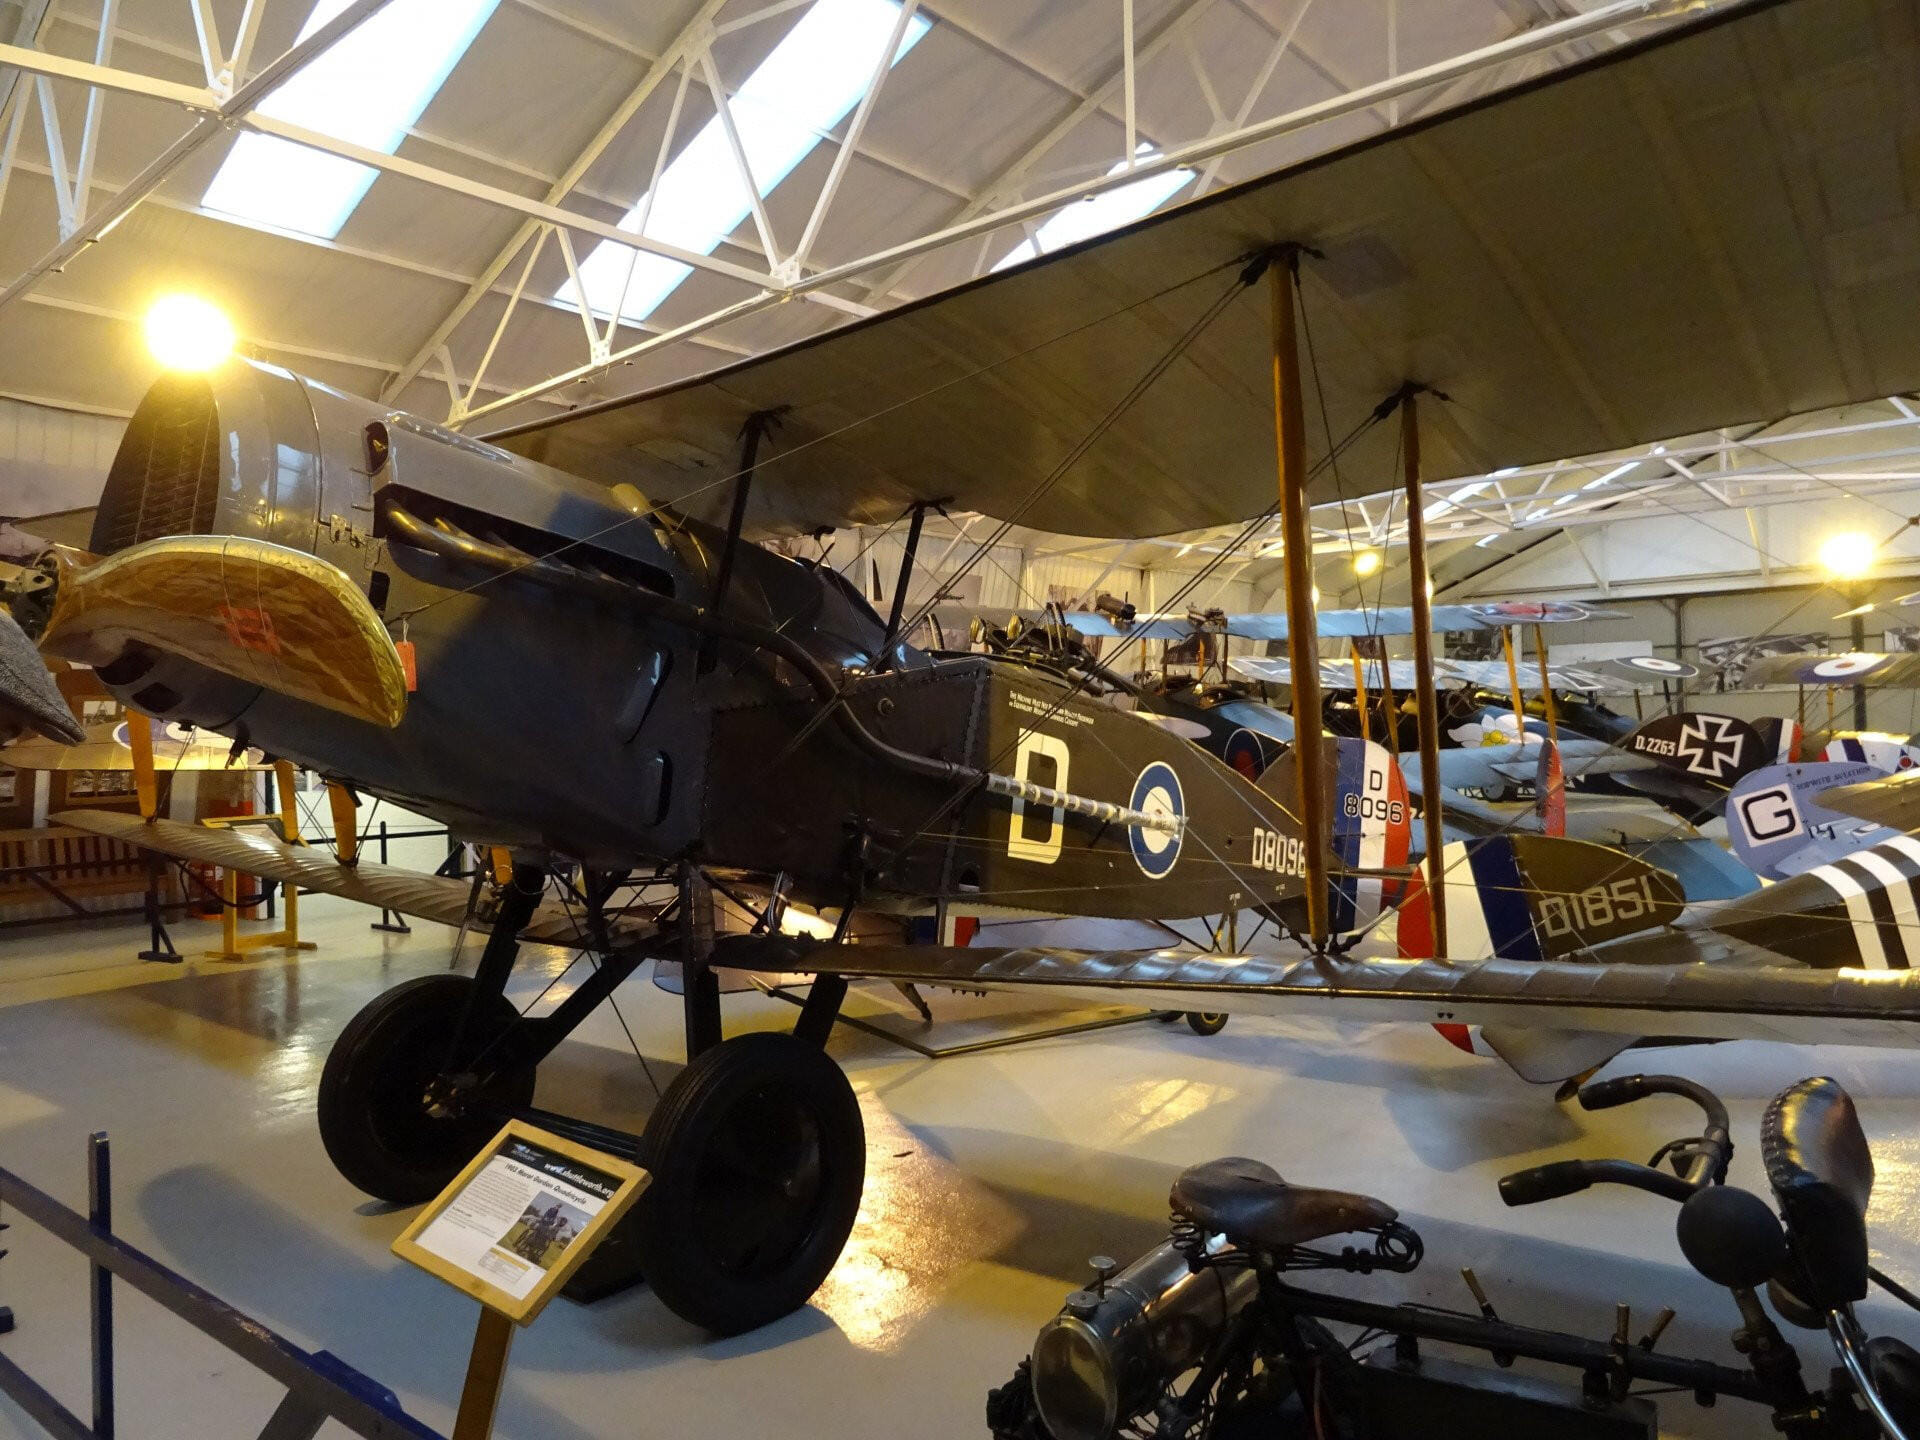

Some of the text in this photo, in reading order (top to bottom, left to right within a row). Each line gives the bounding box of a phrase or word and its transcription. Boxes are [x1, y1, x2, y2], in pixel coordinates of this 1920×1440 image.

[1634, 735, 1676, 756] D.2263
[1008, 727, 1070, 865] D
[1369, 769, 1383, 791] D
[1343, 792, 1403, 824] 8096
[1741, 790, 1796, 840] G
[1538, 875, 1656, 938] D1851
